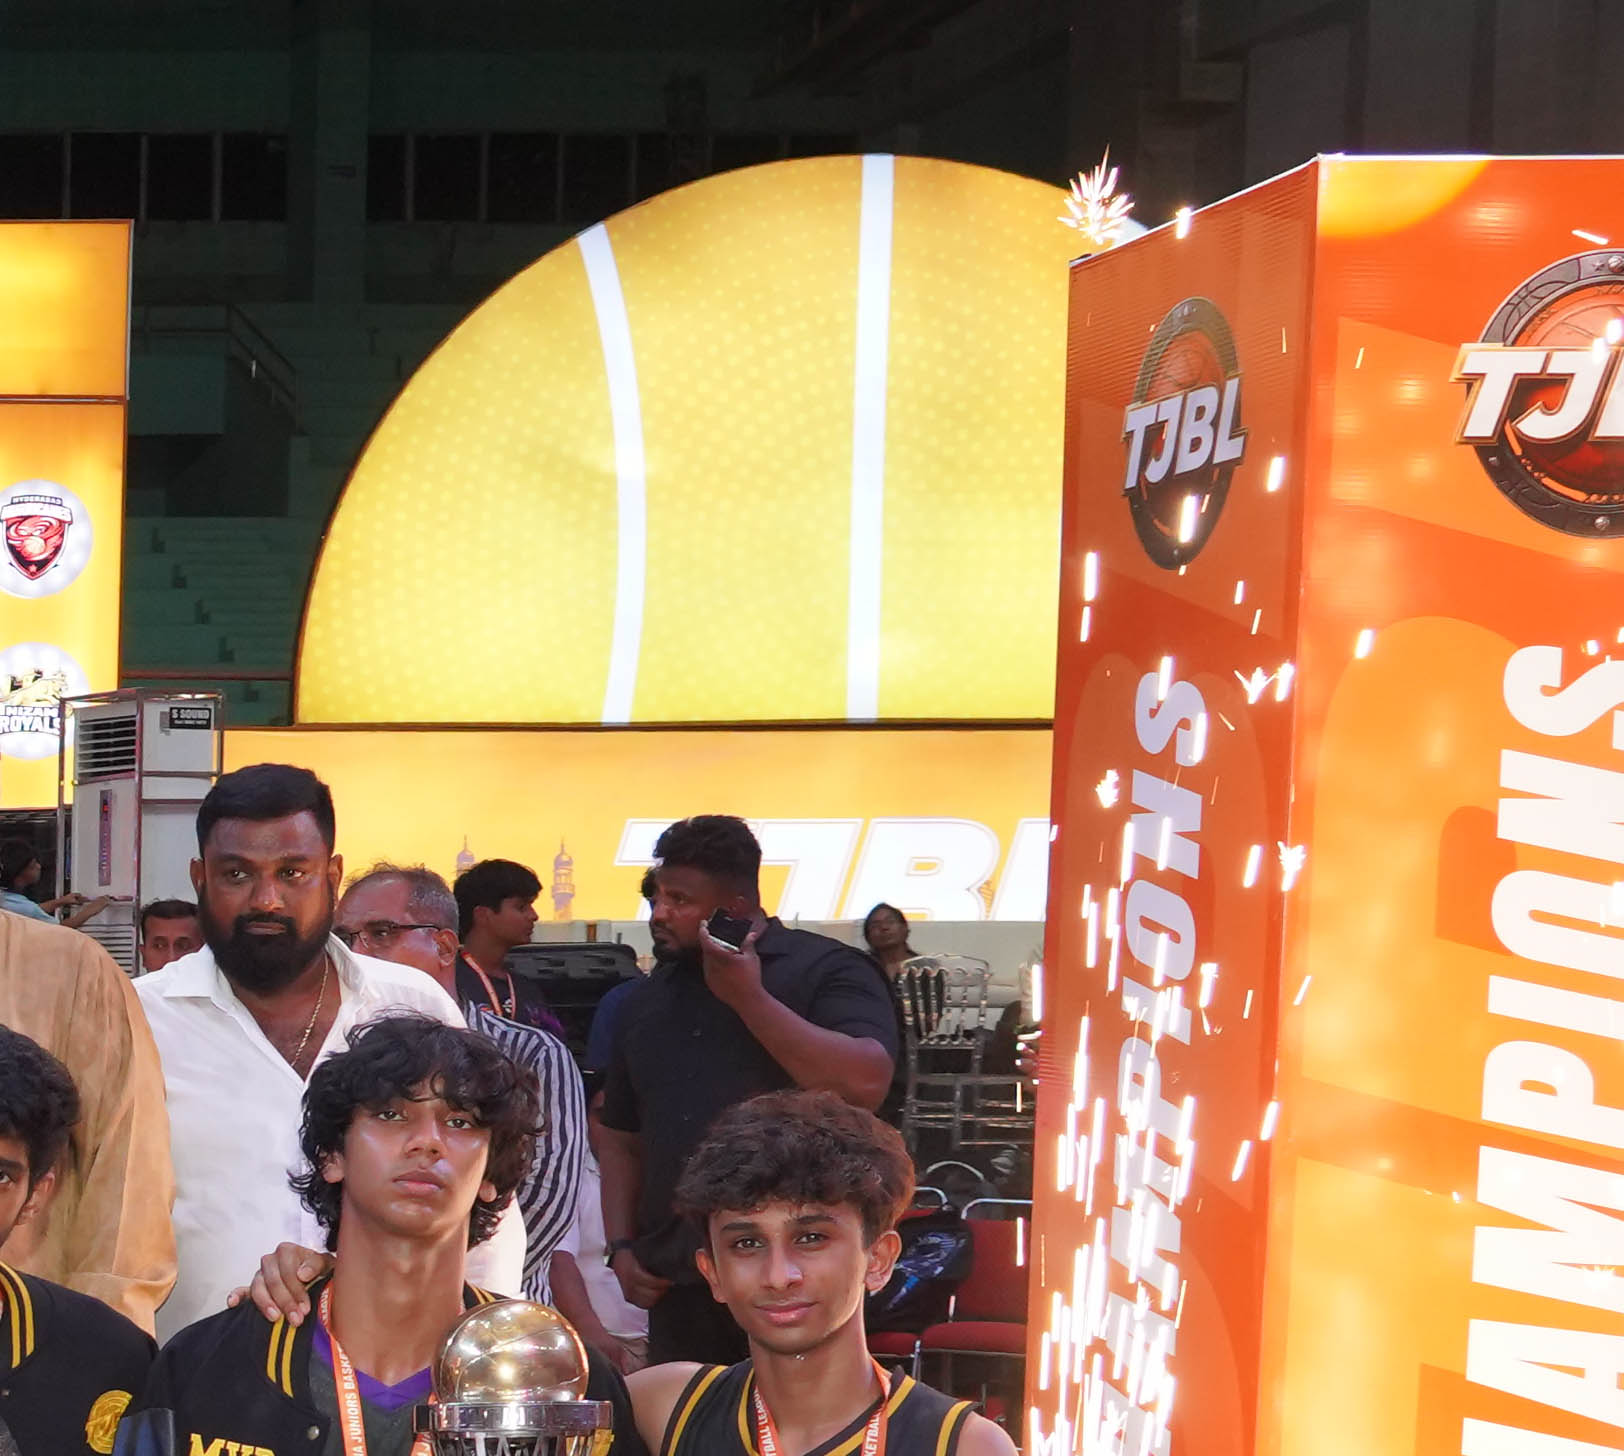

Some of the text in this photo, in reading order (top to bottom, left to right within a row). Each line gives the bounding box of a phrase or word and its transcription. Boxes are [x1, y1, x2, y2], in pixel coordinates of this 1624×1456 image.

[1122, 379, 1247, 489] TJBL
[1460, 347, 1624, 443] TJ
[347, 1392, 363, 1444] JUNIORS
